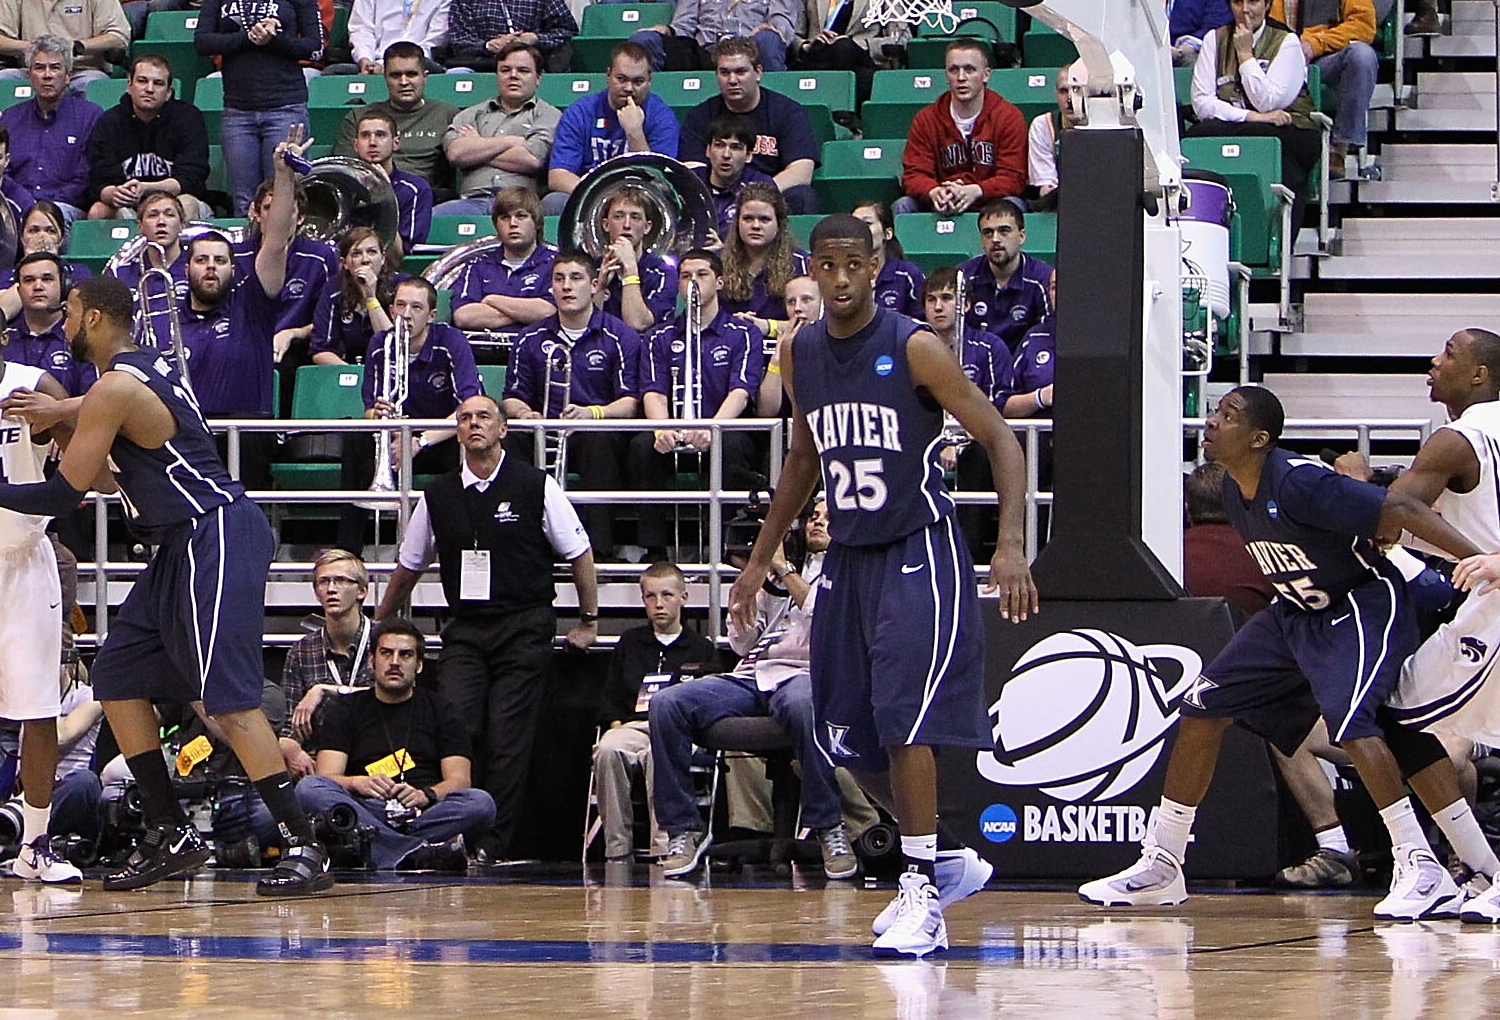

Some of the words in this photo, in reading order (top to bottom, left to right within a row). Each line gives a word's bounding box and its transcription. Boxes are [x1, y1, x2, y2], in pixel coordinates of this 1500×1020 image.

[220, 1, 279, 21] XAVIER
[806, 401, 902, 454] XAVIER
[828, 457, 889, 512] 25
[982, 821, 1016, 833] NCAA
